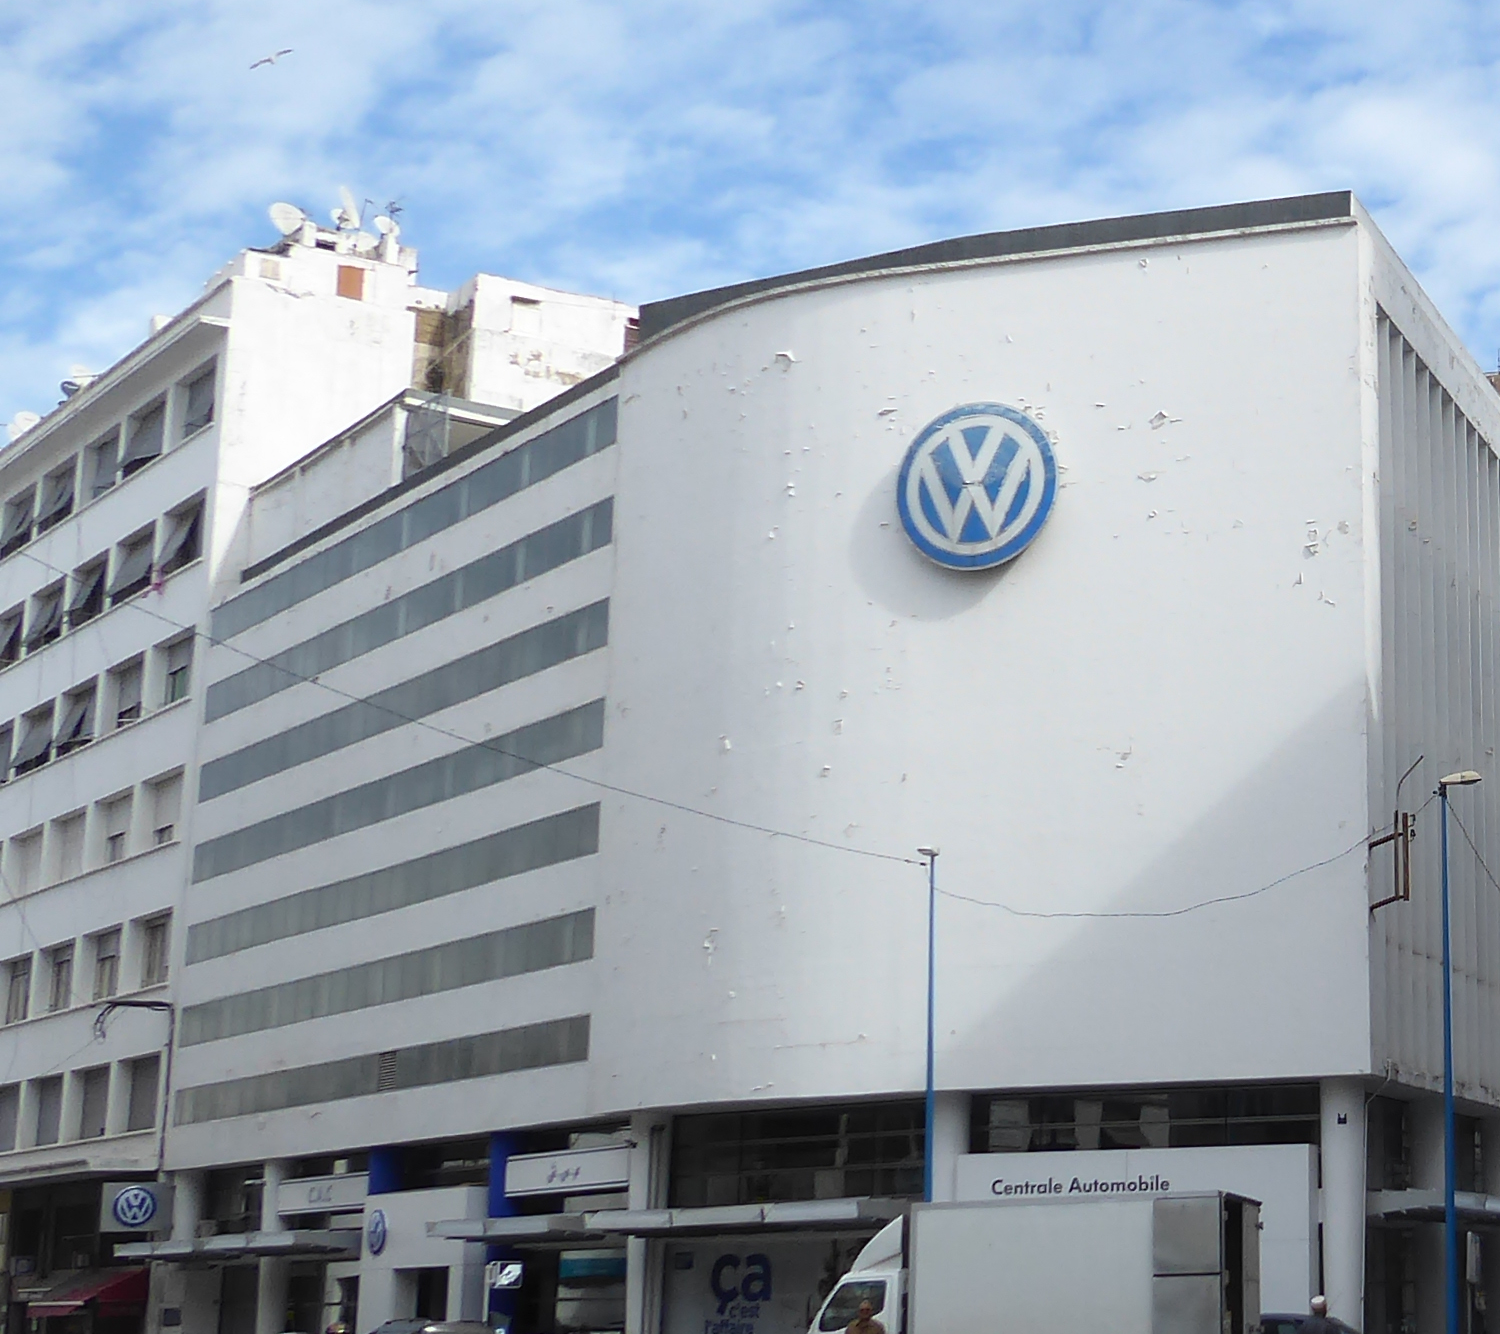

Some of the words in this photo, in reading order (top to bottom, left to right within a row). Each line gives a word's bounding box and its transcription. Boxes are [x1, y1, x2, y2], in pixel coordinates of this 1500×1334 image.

[991, 1178, 1063, 1195] Centrale
[1068, 1174, 1170, 1193] Automobile
[711, 1253, 772, 1315] ça
